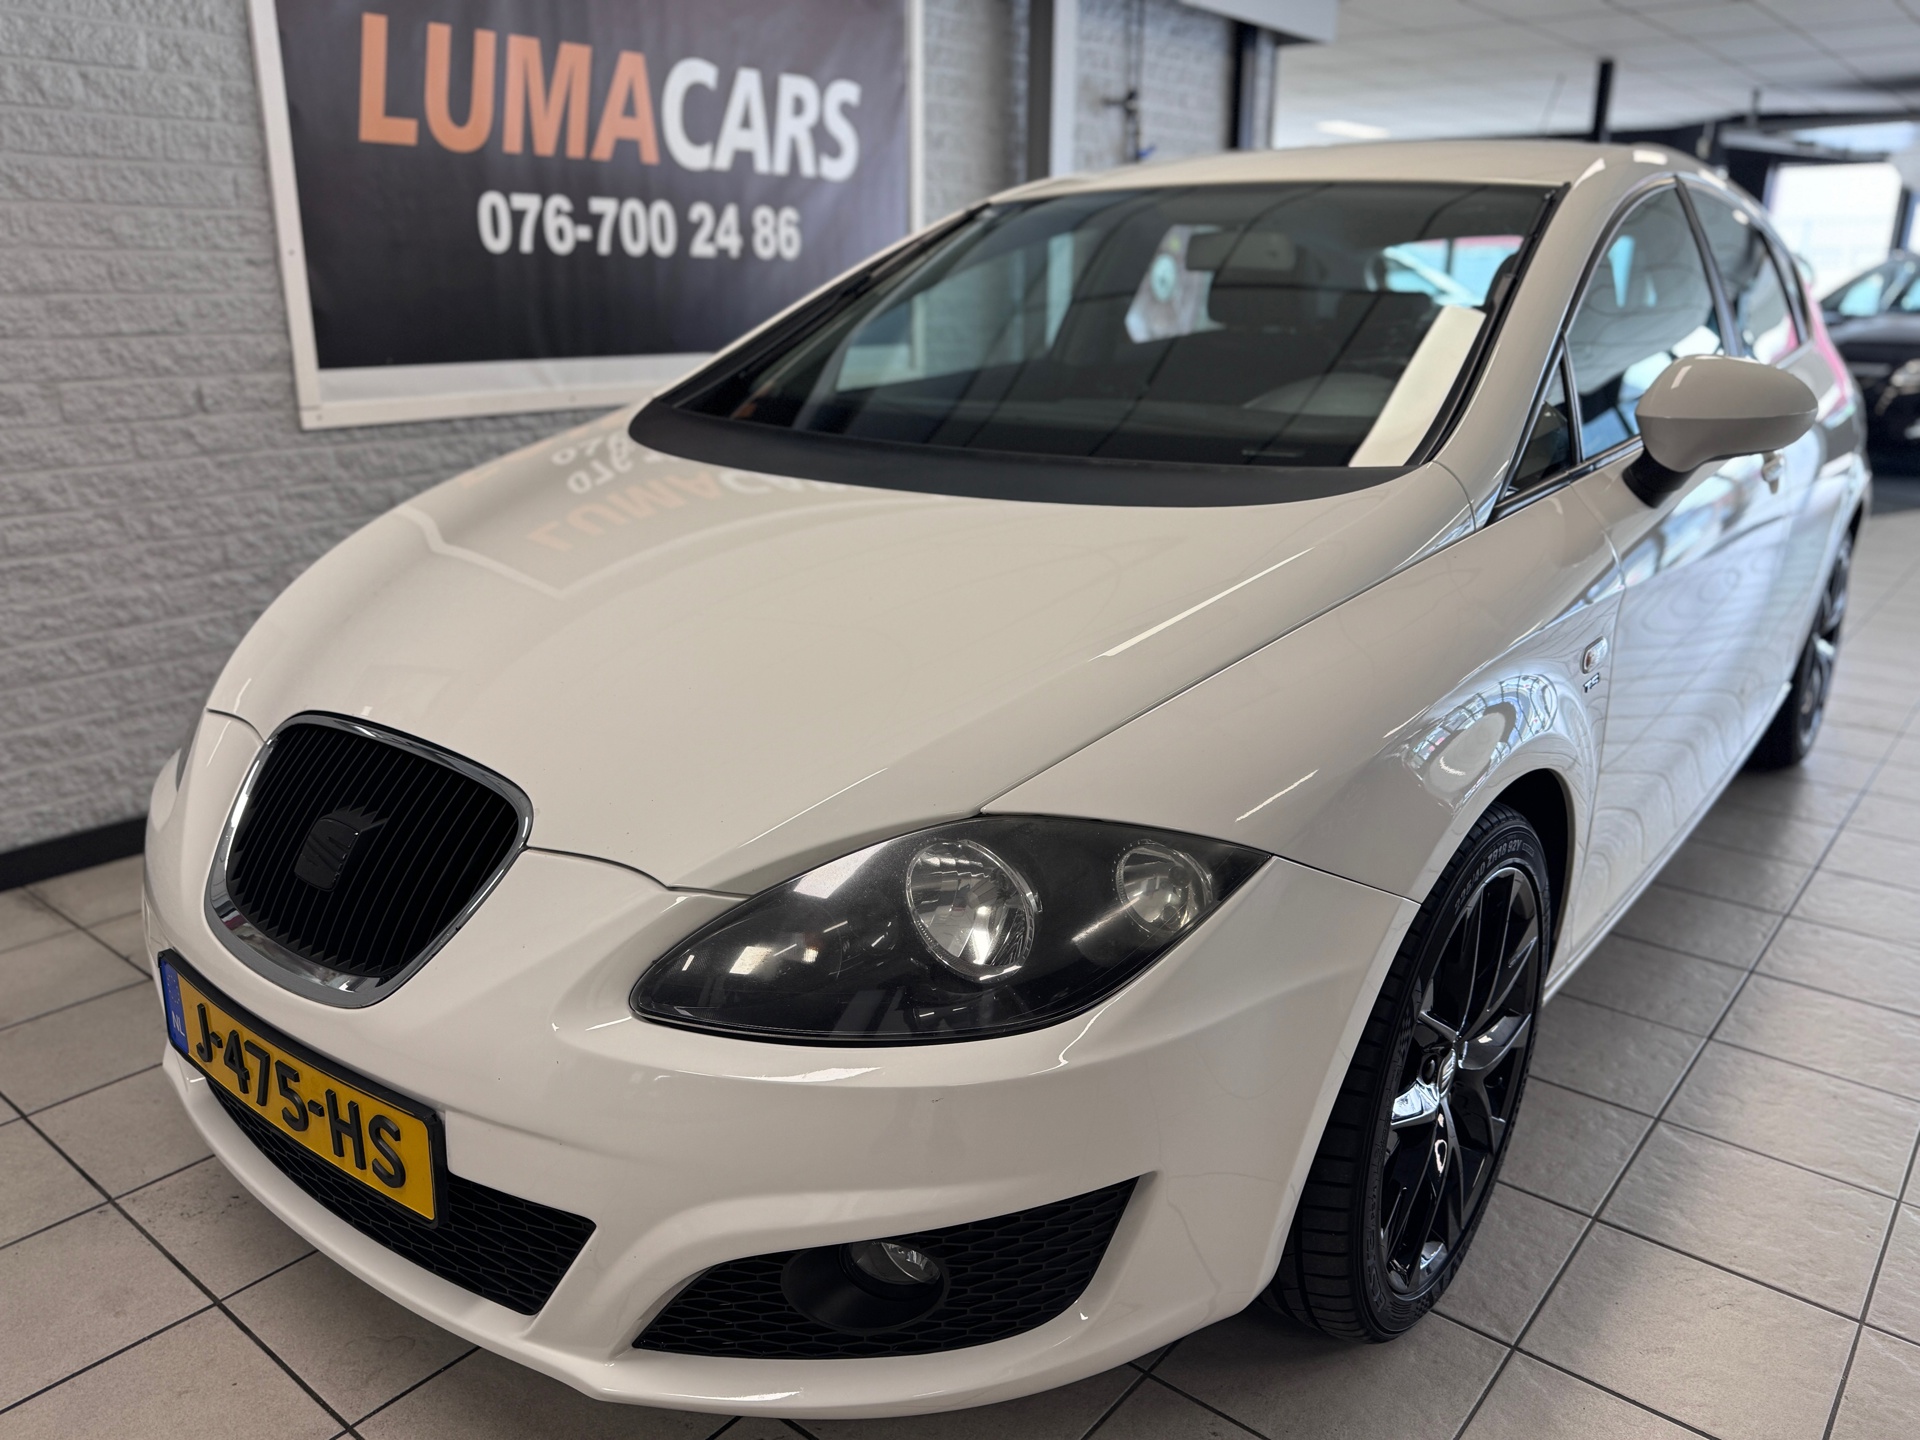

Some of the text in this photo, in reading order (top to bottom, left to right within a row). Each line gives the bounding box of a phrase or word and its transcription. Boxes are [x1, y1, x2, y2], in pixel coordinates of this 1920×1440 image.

[477, 190, 801, 261] 076-700 24 86
[171, 1010, 186, 1037] NL
[196, 1002, 406, 1189] J-475-HS
